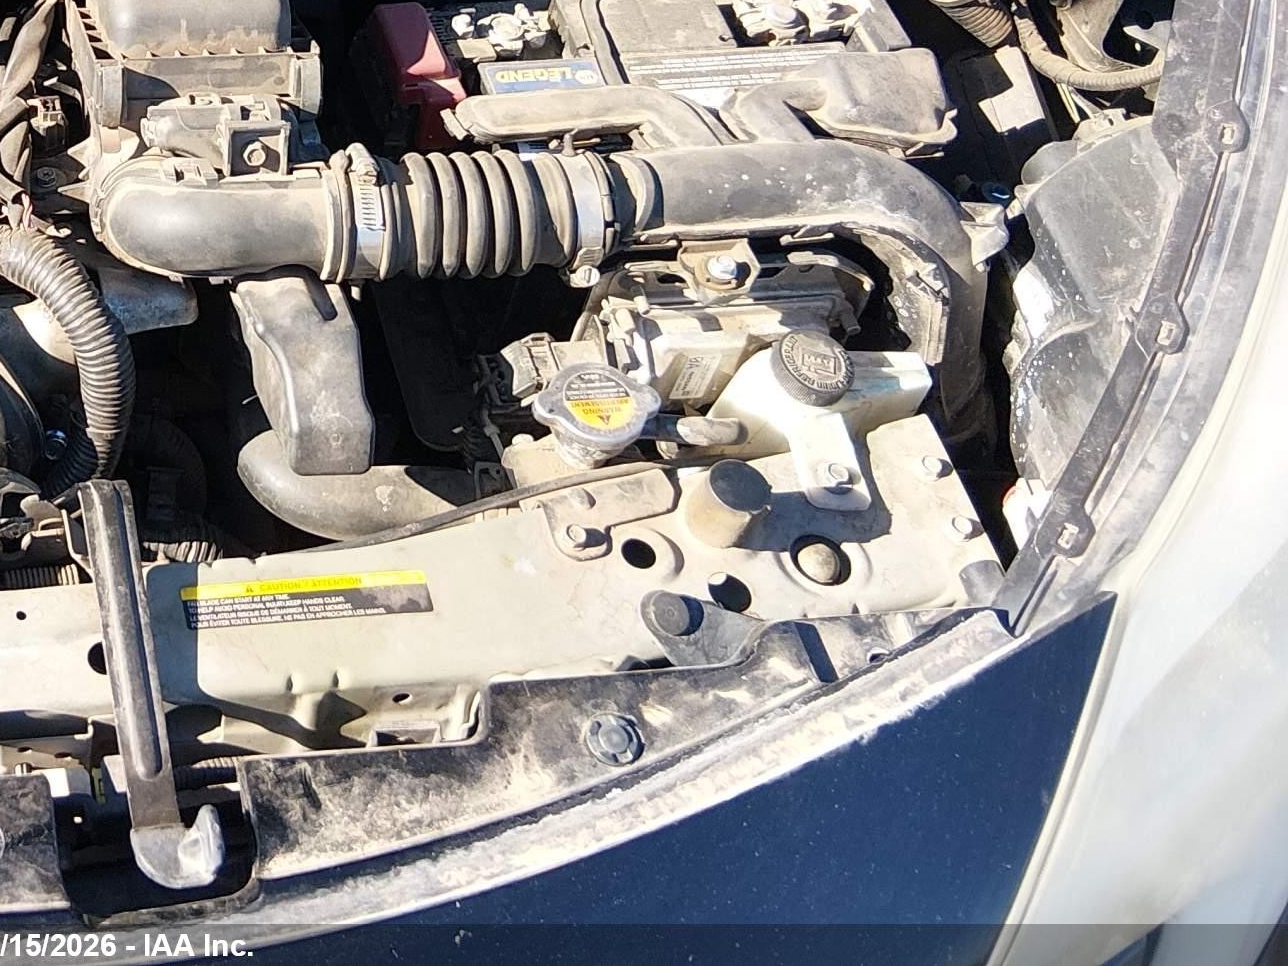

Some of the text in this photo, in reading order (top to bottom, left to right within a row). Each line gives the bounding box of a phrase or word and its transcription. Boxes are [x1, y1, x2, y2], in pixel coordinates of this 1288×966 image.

[495, 67, 573, 84] LEGEND
[259, 582, 302, 592] CAUTION
[311, 577, 362, 588] ATTENTION
